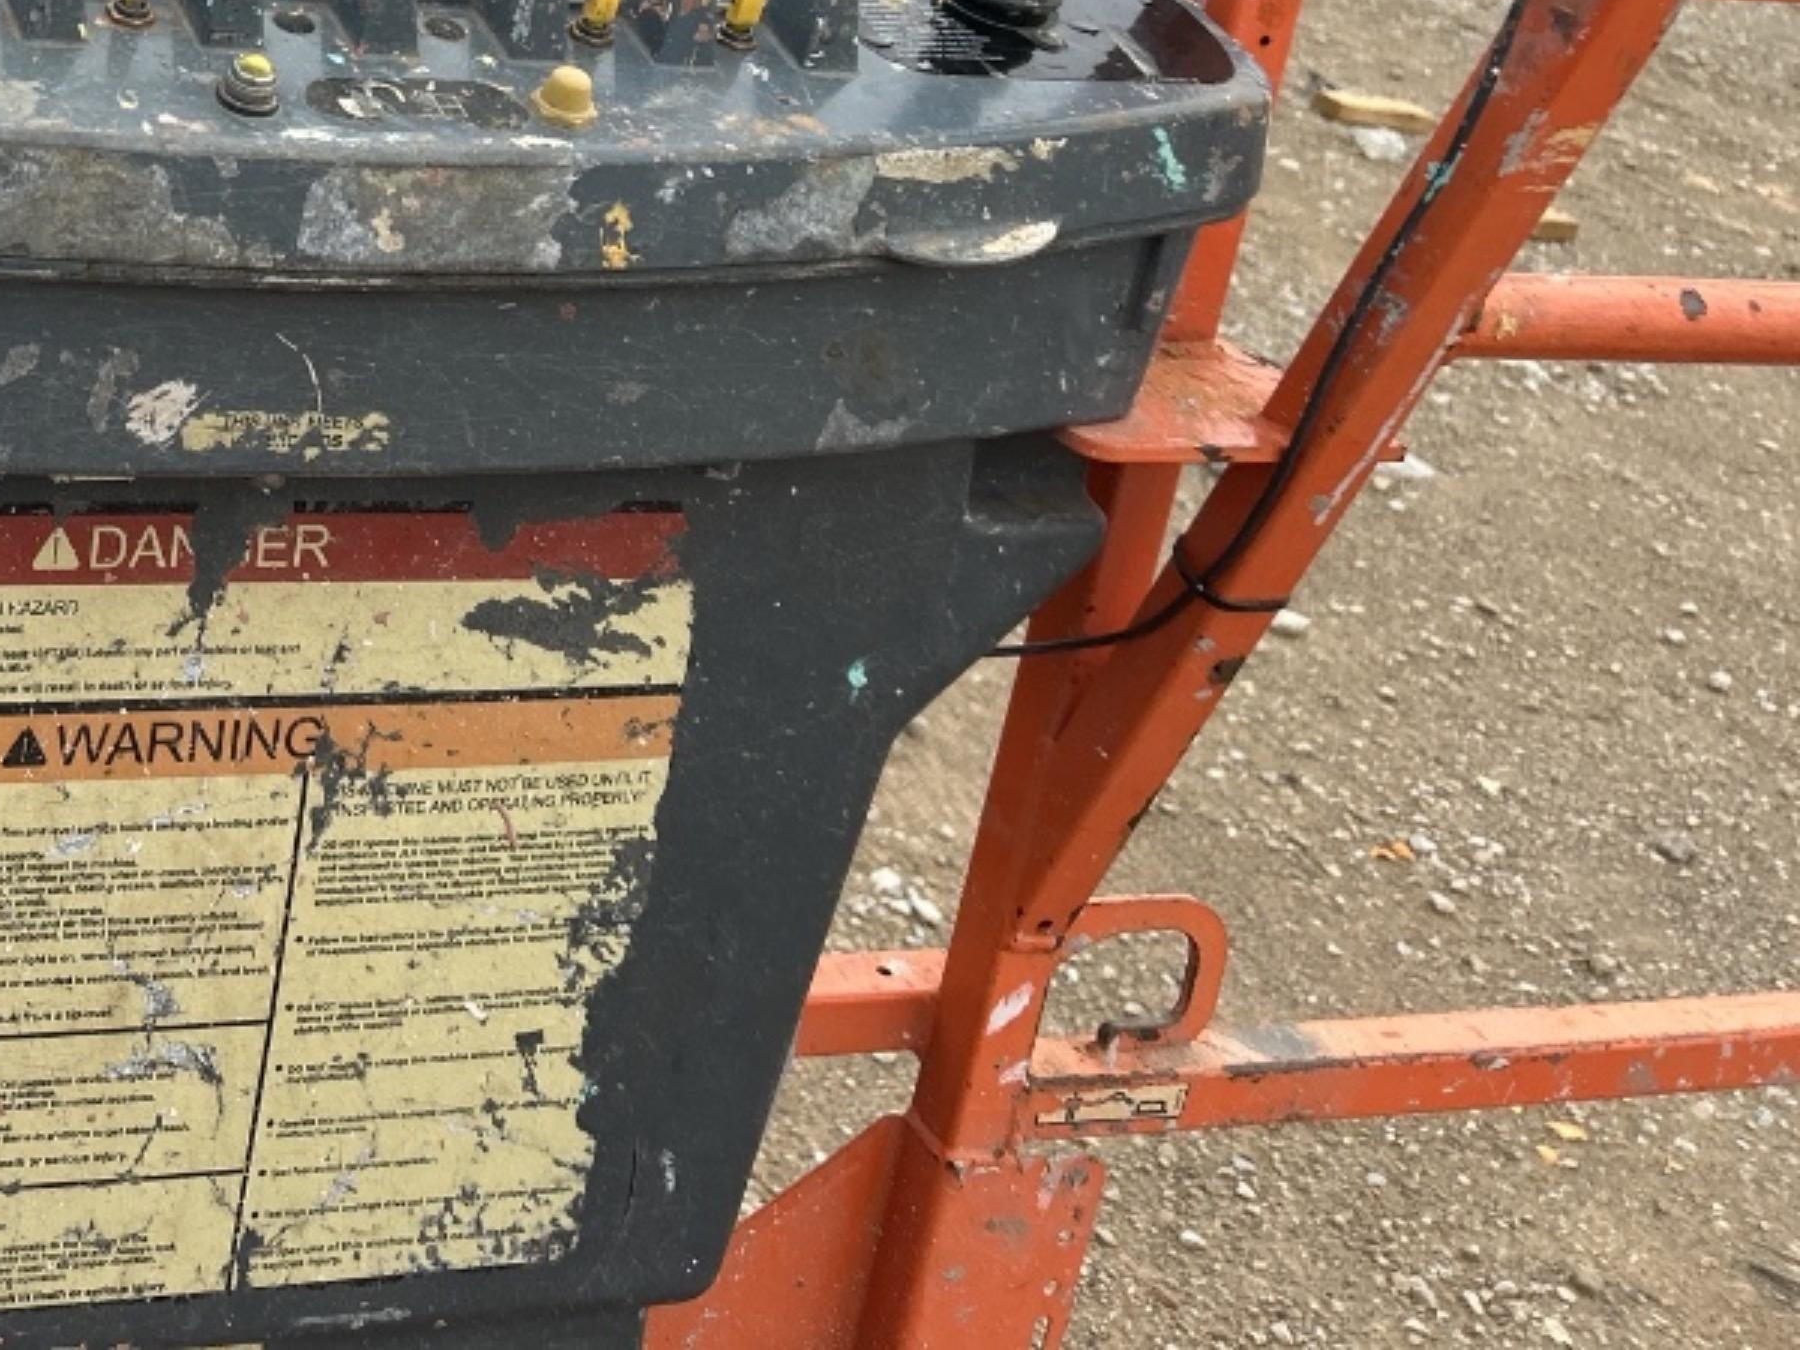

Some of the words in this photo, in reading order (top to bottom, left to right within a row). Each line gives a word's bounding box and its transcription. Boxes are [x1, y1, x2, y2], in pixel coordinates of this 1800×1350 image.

[89, 524, 330, 569] DANER
[8, 600, 79, 617] HAZARD
[57, 716, 324, 766] WARNING
